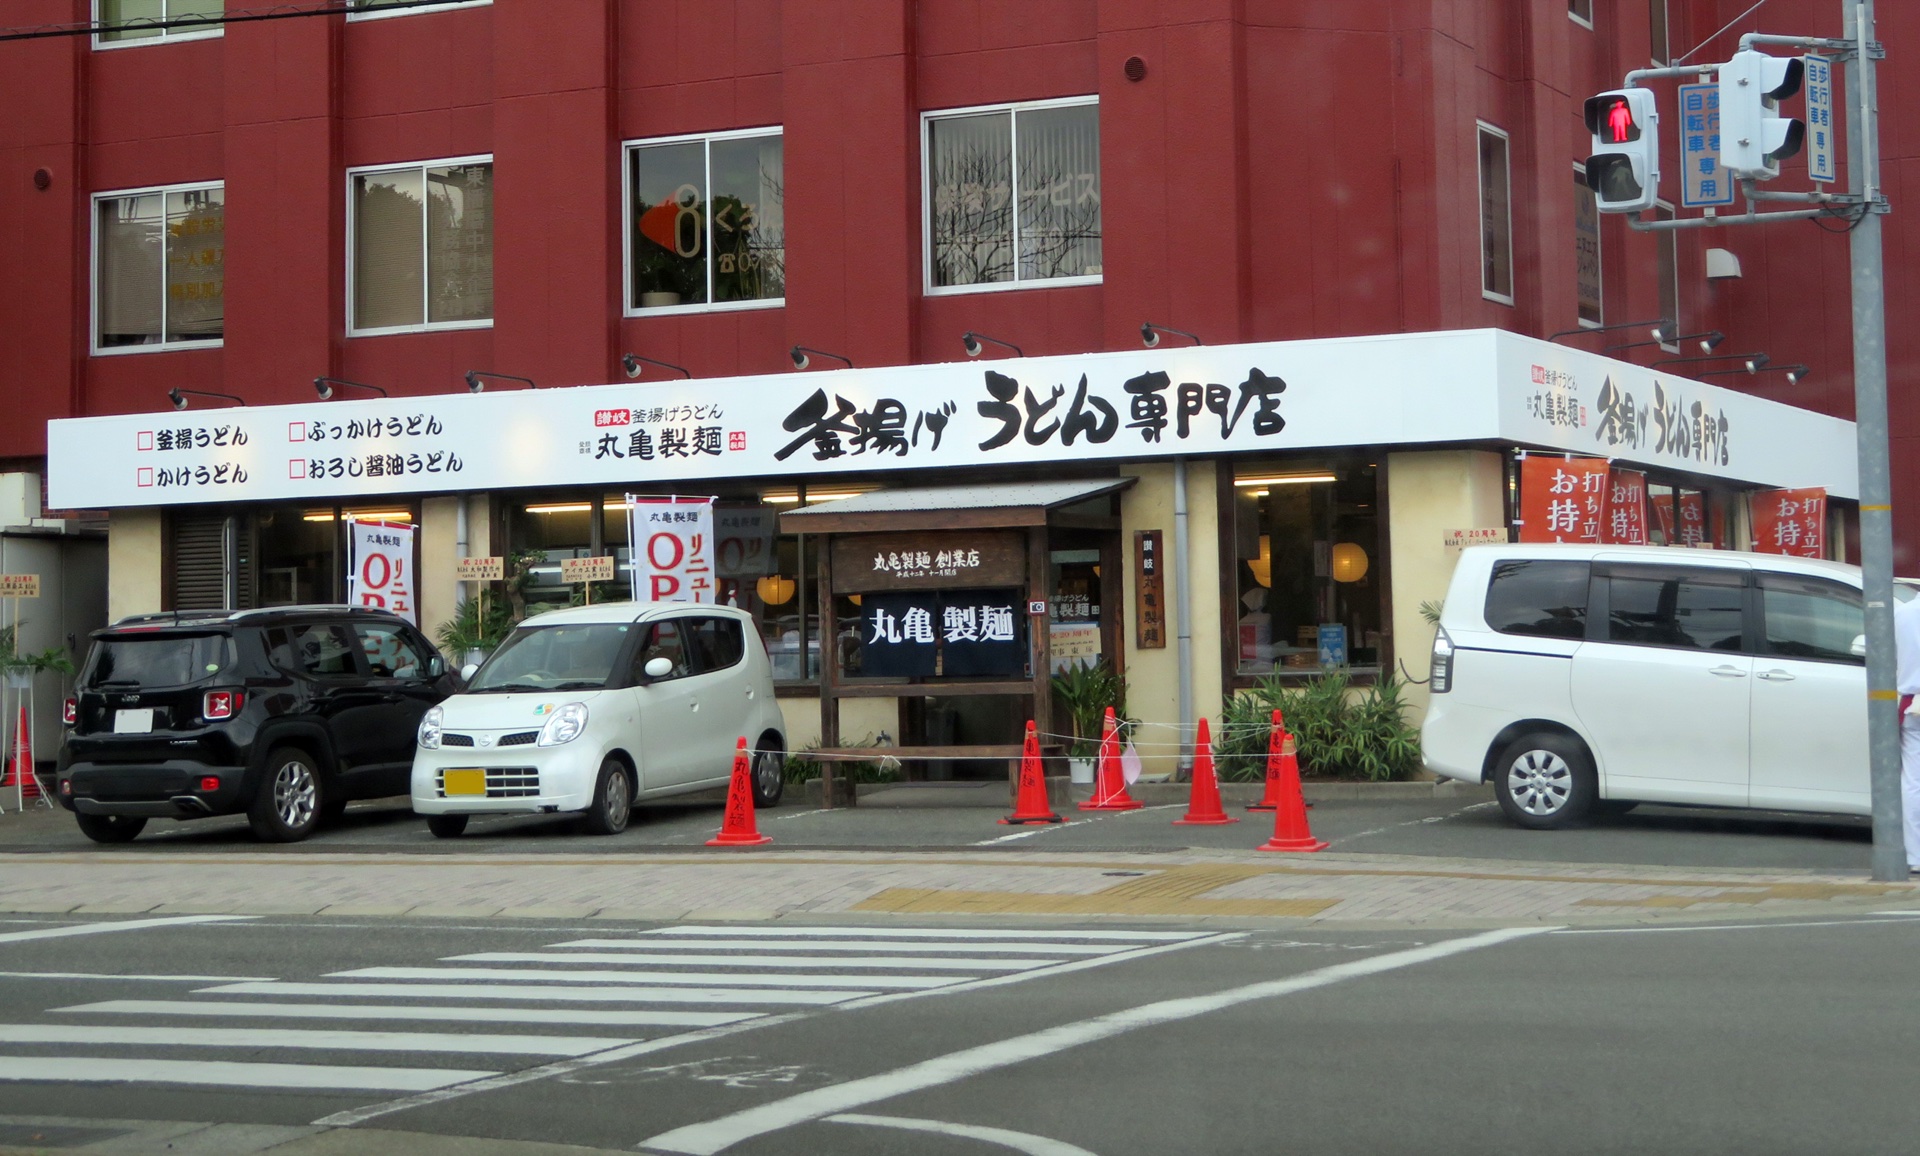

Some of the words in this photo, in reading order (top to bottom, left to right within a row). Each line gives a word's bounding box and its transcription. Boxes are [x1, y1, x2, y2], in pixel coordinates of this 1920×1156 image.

[1809, 64, 1819, 125] 自転車
[1819, 65, 1828, 126] 歩行者
[1687, 93, 1705, 153] 自転車
[1816, 131, 1826, 172] 専用
[1698, 157, 1717, 198] 専用
[308, 413, 443, 441] ぶっかけうどん
[596, 410, 629, 426] 讃岐
[631, 403, 724, 424] 釜揚げうどん
[773, 366, 1287, 462] 釜揚げうどん専門店
[1533, 389, 1579, 429] 丸亀製麺
[1595, 373, 1729, 467] 釜揚げうどん専門店
[156, 425, 248, 451] 釜揚うどん
[594, 425, 723, 460] 丸亀製麺
[156, 463, 248, 487] かけうどん
[309, 451, 463, 479] おろし醤油うどん
[649, 511, 698, 523] 丸亀製麺
[1547, 467, 1580, 544] お持
[1580, 471, 1604, 544] 打ち立
[1610, 480, 1628, 544] お持
[1627, 485, 1642, 545] 打ち立
[366, 534, 401, 547] 丸亀製麺
[1469, 529, 1497, 538] 20周年
[1774, 497, 1801, 557] お持
[872, 551, 931, 571] 丸亀製麺
[934, 548, 980, 569] 創業店
[868, 604, 1015, 645] 丸亀製麺
[1143, 576, 1159, 642] 丸亀製麺
